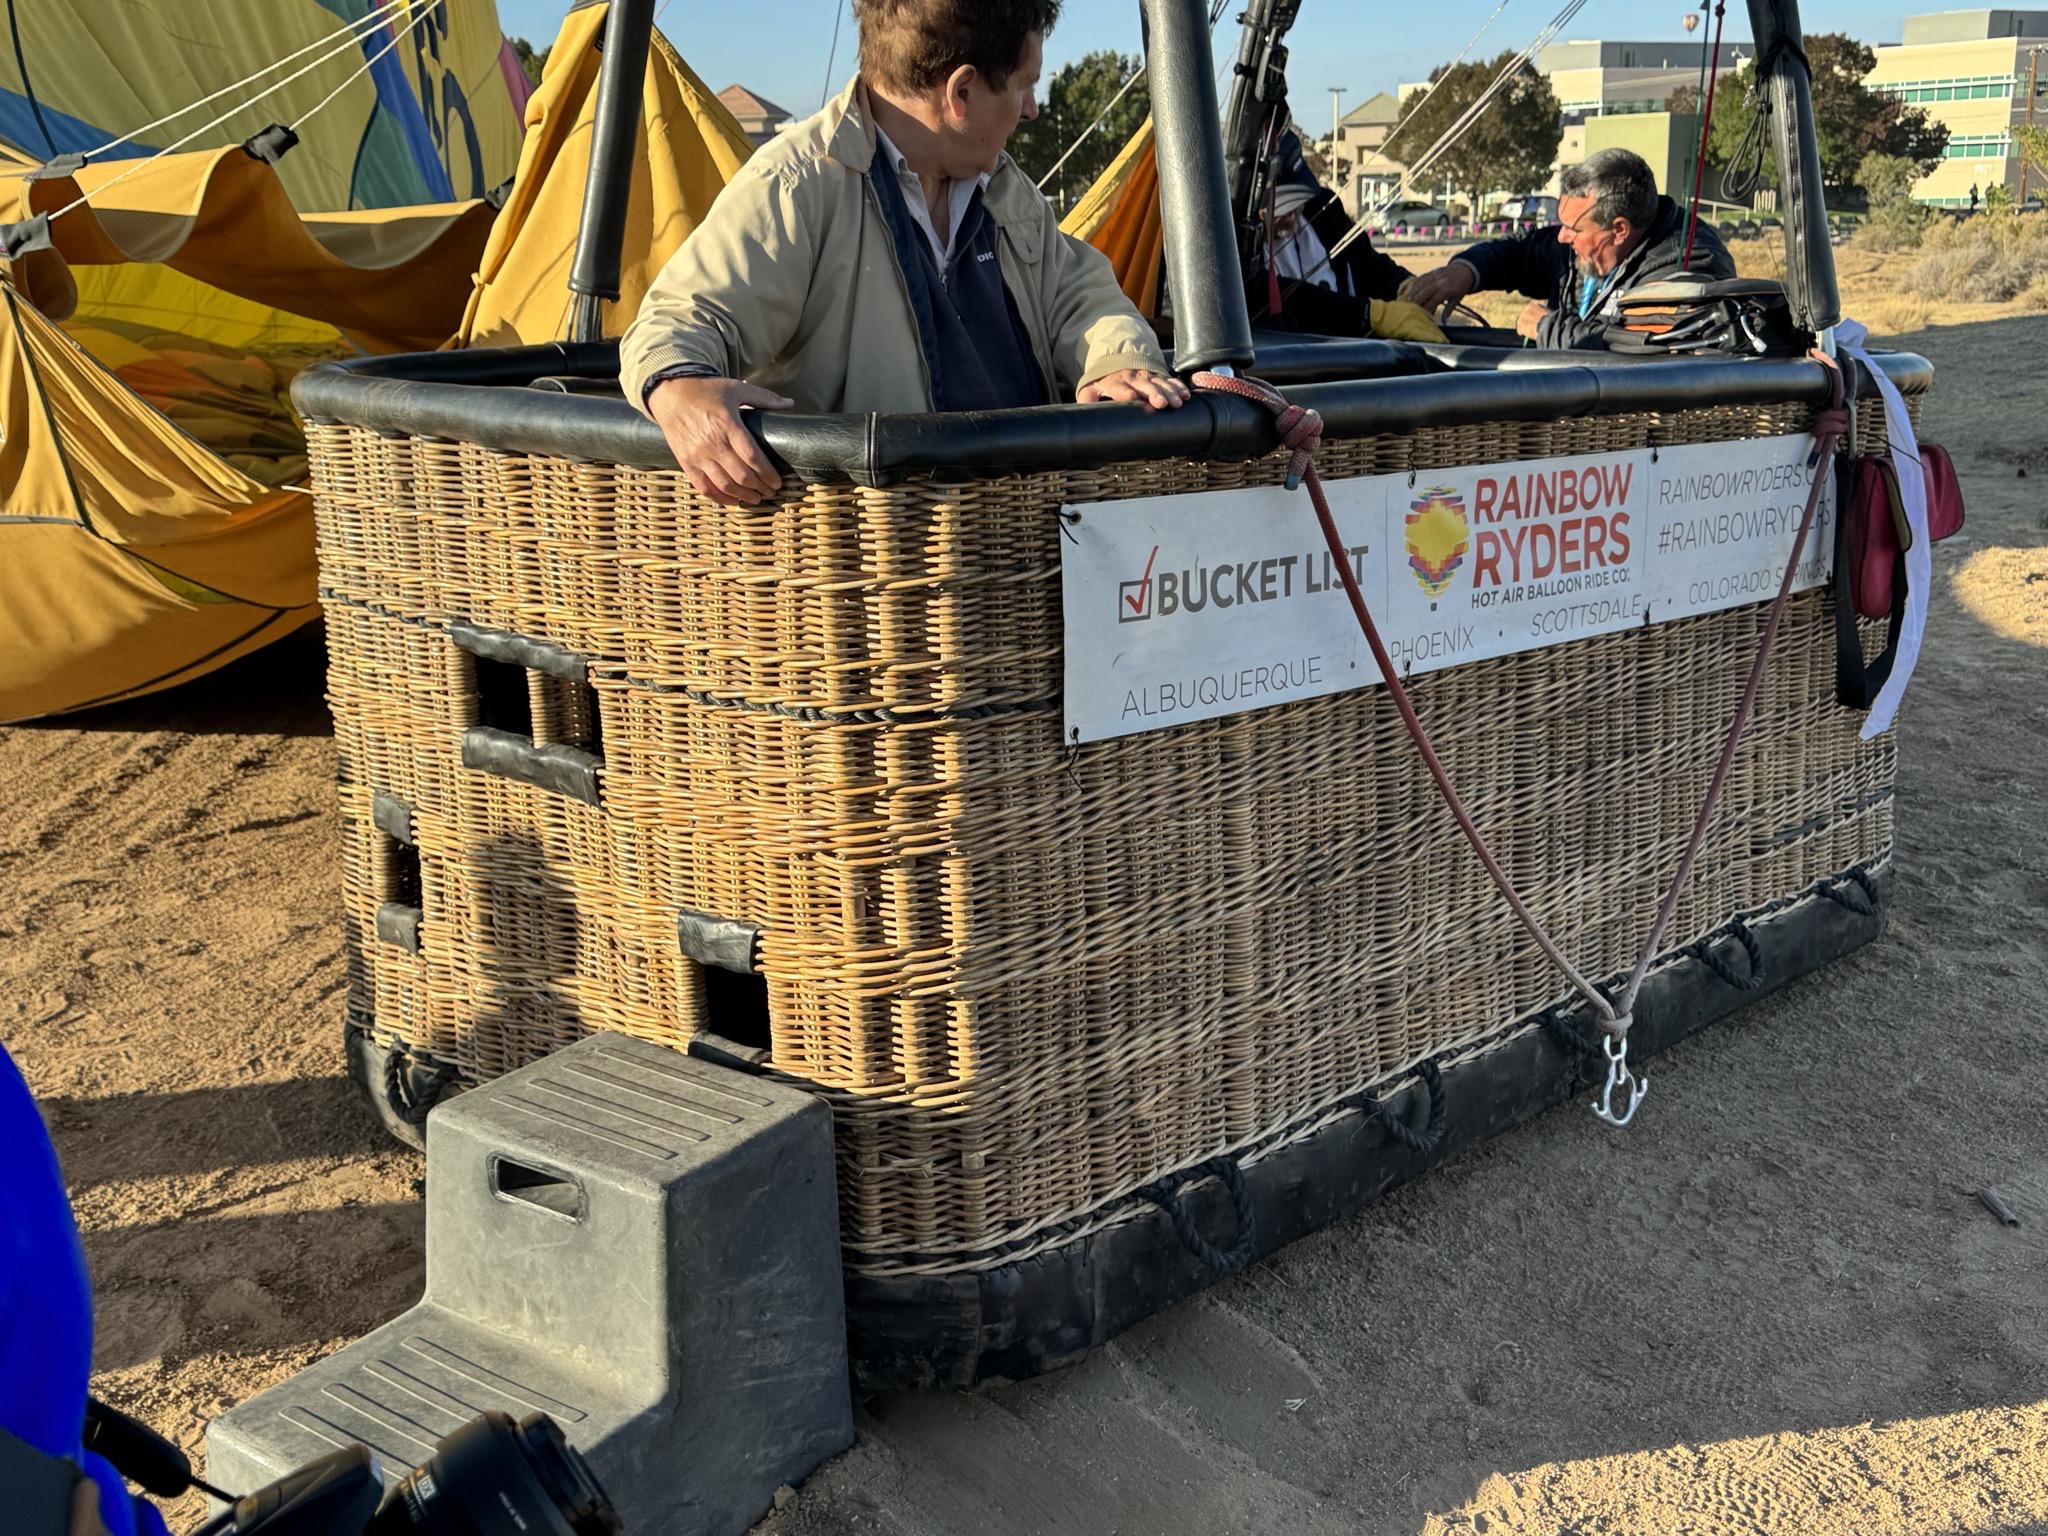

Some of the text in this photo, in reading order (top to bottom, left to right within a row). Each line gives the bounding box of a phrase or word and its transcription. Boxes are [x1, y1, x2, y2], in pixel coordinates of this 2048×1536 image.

[1473, 462, 1634, 524] RAINBOW
[1659, 461, 1829, 506] RAINBOWRYDERS.C
[1473, 512, 1631, 588] RYDERS
[1657, 499, 1831, 554] #RAINBOWRYDRS
[1157, 555, 1298, 616] BUCKET
[1471, 590, 1499, 609] HOT
[1501, 586, 1524, 604] AIR
[1527, 576, 1582, 600] BALLOON
[1585, 571, 1609, 590] RIDE
[1121, 556, 1827, 720] ALBUQUERQUE PHOENIX SCOTTSDALE COLORADO SRINGS
